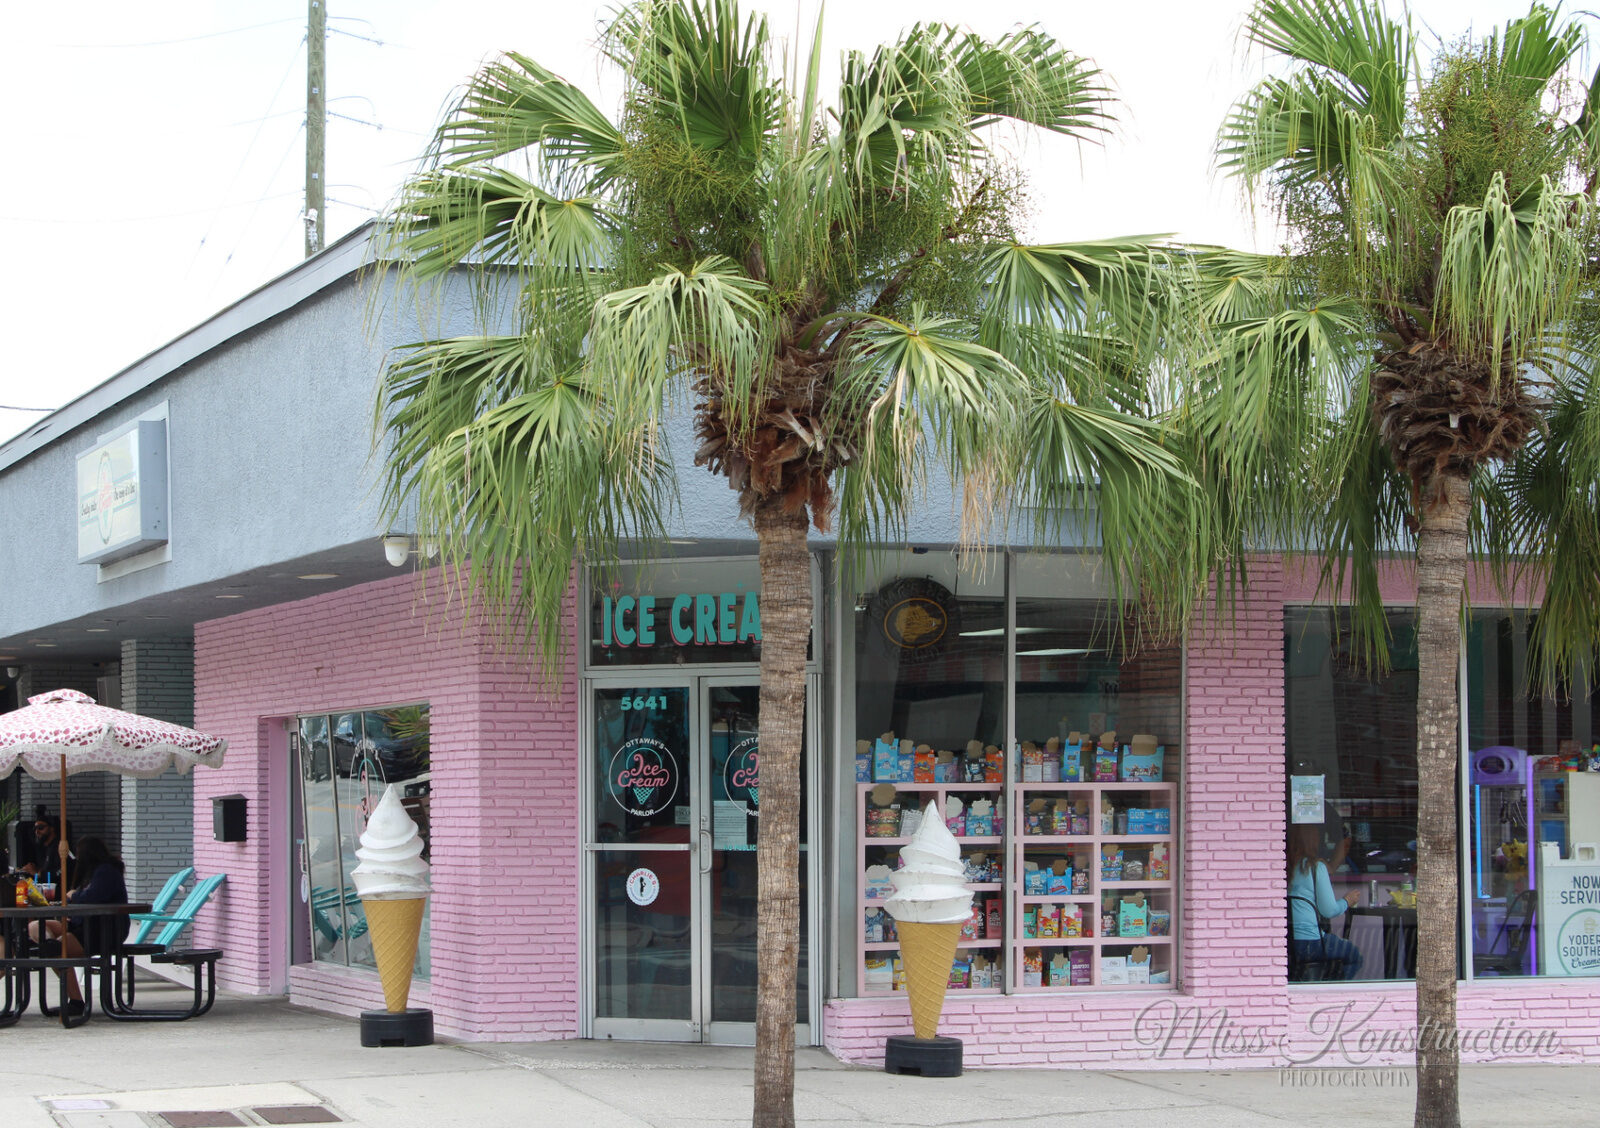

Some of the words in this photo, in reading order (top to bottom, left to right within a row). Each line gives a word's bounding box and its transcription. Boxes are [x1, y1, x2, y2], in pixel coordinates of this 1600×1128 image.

[601, 595, 656, 648] ICE
[670, 591, 762, 647] CREA
[620, 695, 668, 711] 5641
[625, 737, 665, 751] OTTAWAY'S
[630, 753, 660, 777] Ice
[617, 768, 670, 788] Cream
[732, 769, 760, 787] Cre
[630, 807, 655, 818] PARLOR
[746, 808, 759, 816] PAR
[1573, 875, 1600, 889] NOW
[1560, 890, 1600, 905] SERVI
[1568, 934, 1600, 946] YODER
[1562, 946, 1600, 957] SOUTHE
